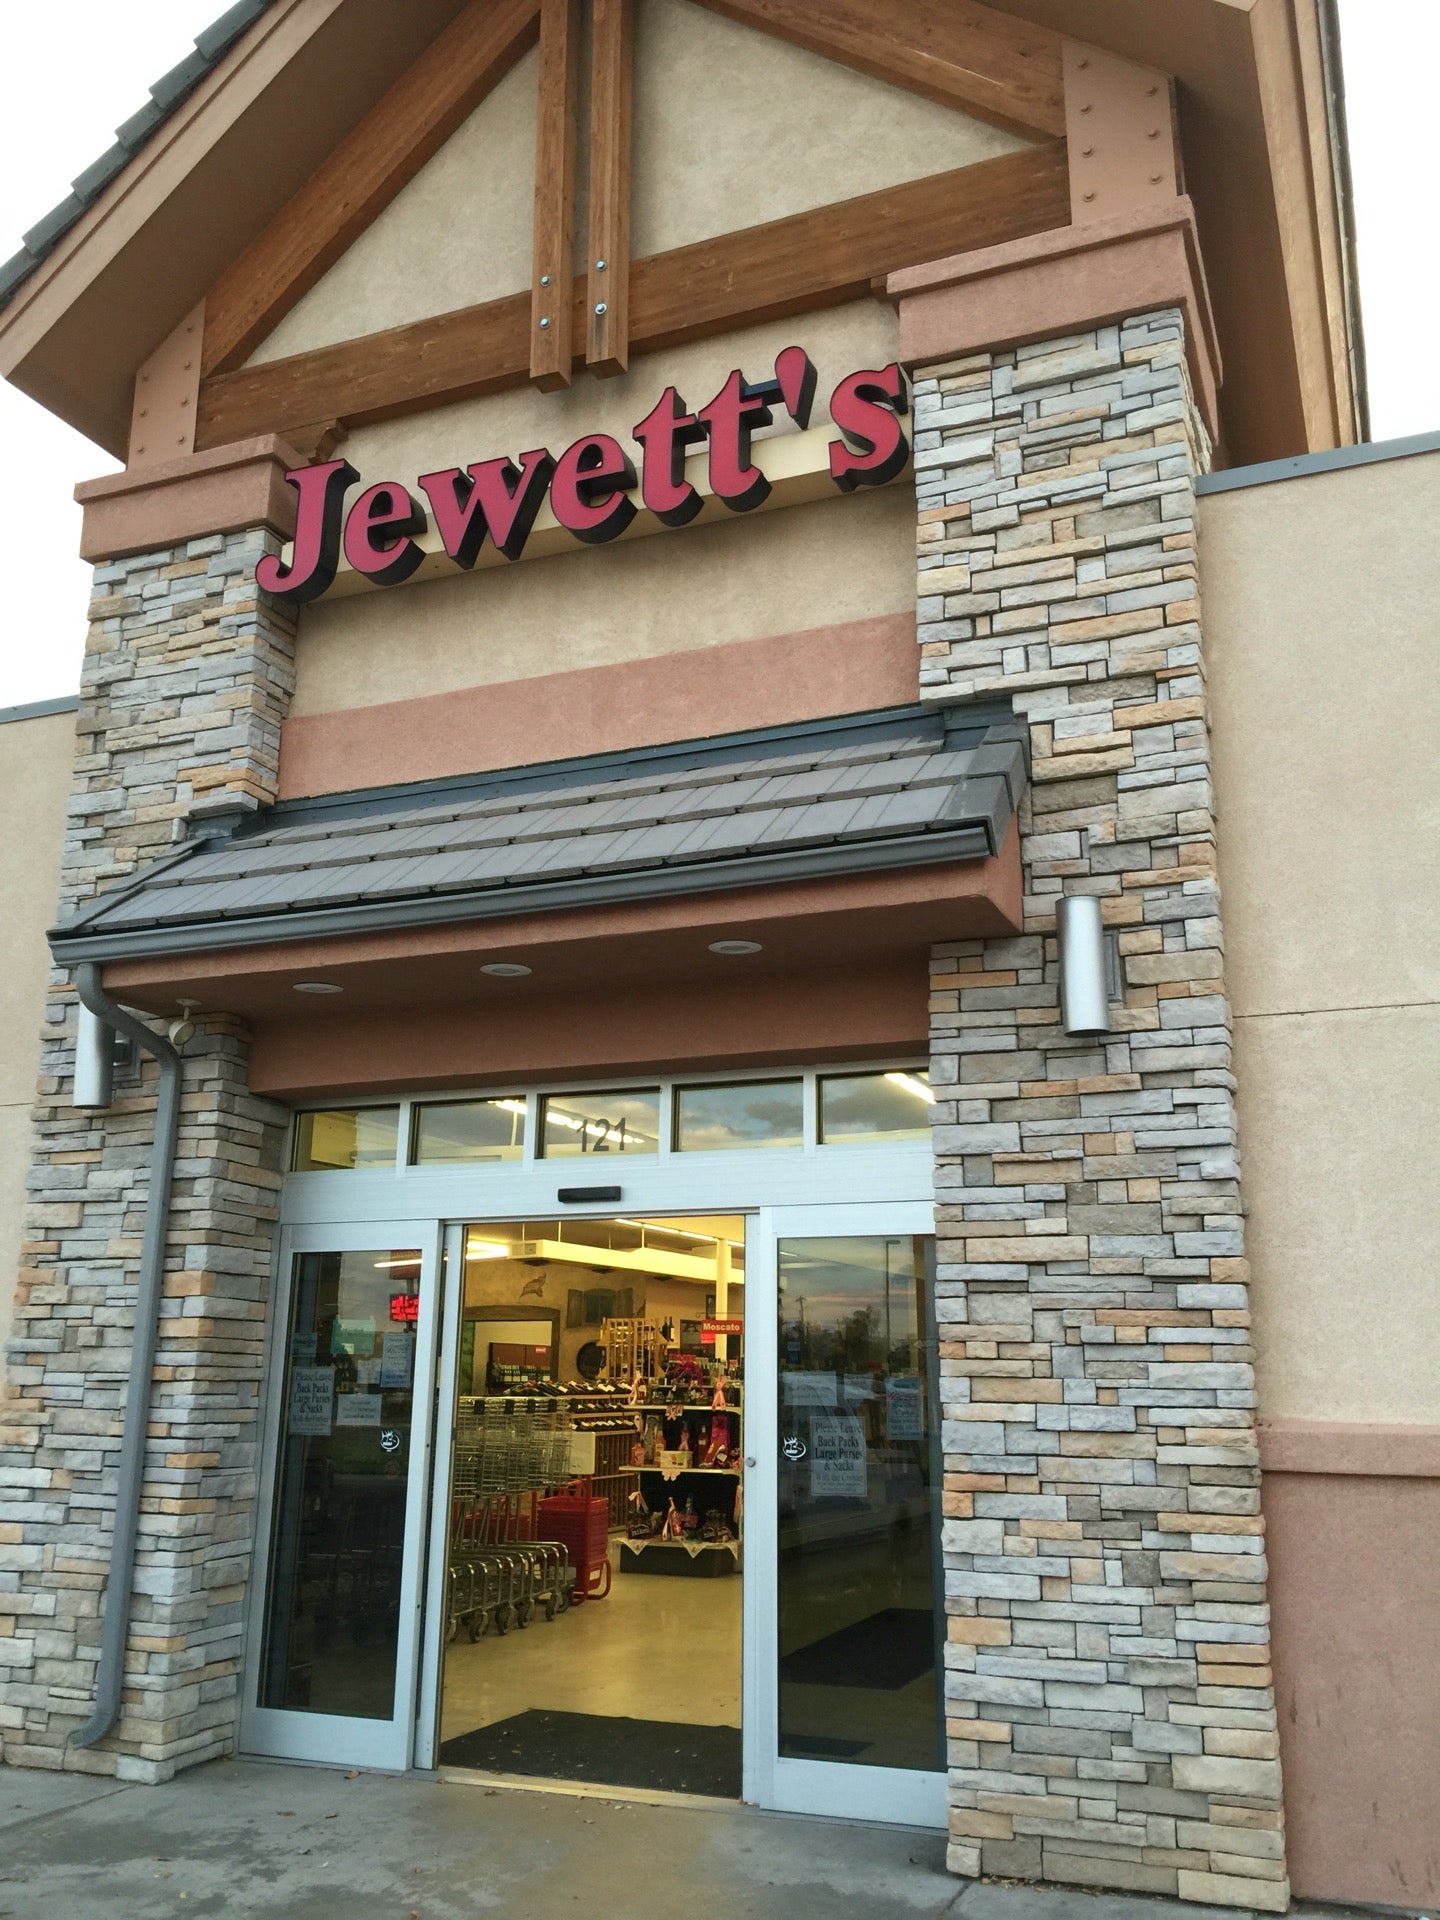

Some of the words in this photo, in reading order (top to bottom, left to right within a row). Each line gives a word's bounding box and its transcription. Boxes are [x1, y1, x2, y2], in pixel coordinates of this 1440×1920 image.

[255, 346, 907, 600] Jewett's
[576, 1117, 626, 1152] 121
[703, 1322, 740, 1331] Moscato
[297, 1383, 311, 1393] Back
[312, 1383, 329, 1393] Packs
[294, 1393, 311, 1404] Large
[312, 1393, 330, 1403] Purses
[815, 1422, 838, 1433] Please
[840, 1422, 864, 1433] Leave
[818, 1436, 836, 1447] Back
[838, 1436, 859, 1447] Packs
[815, 1448, 837, 1460] Large
[839, 1448, 862, 1459] Purses
[833, 1461, 854, 1471] Sacks
